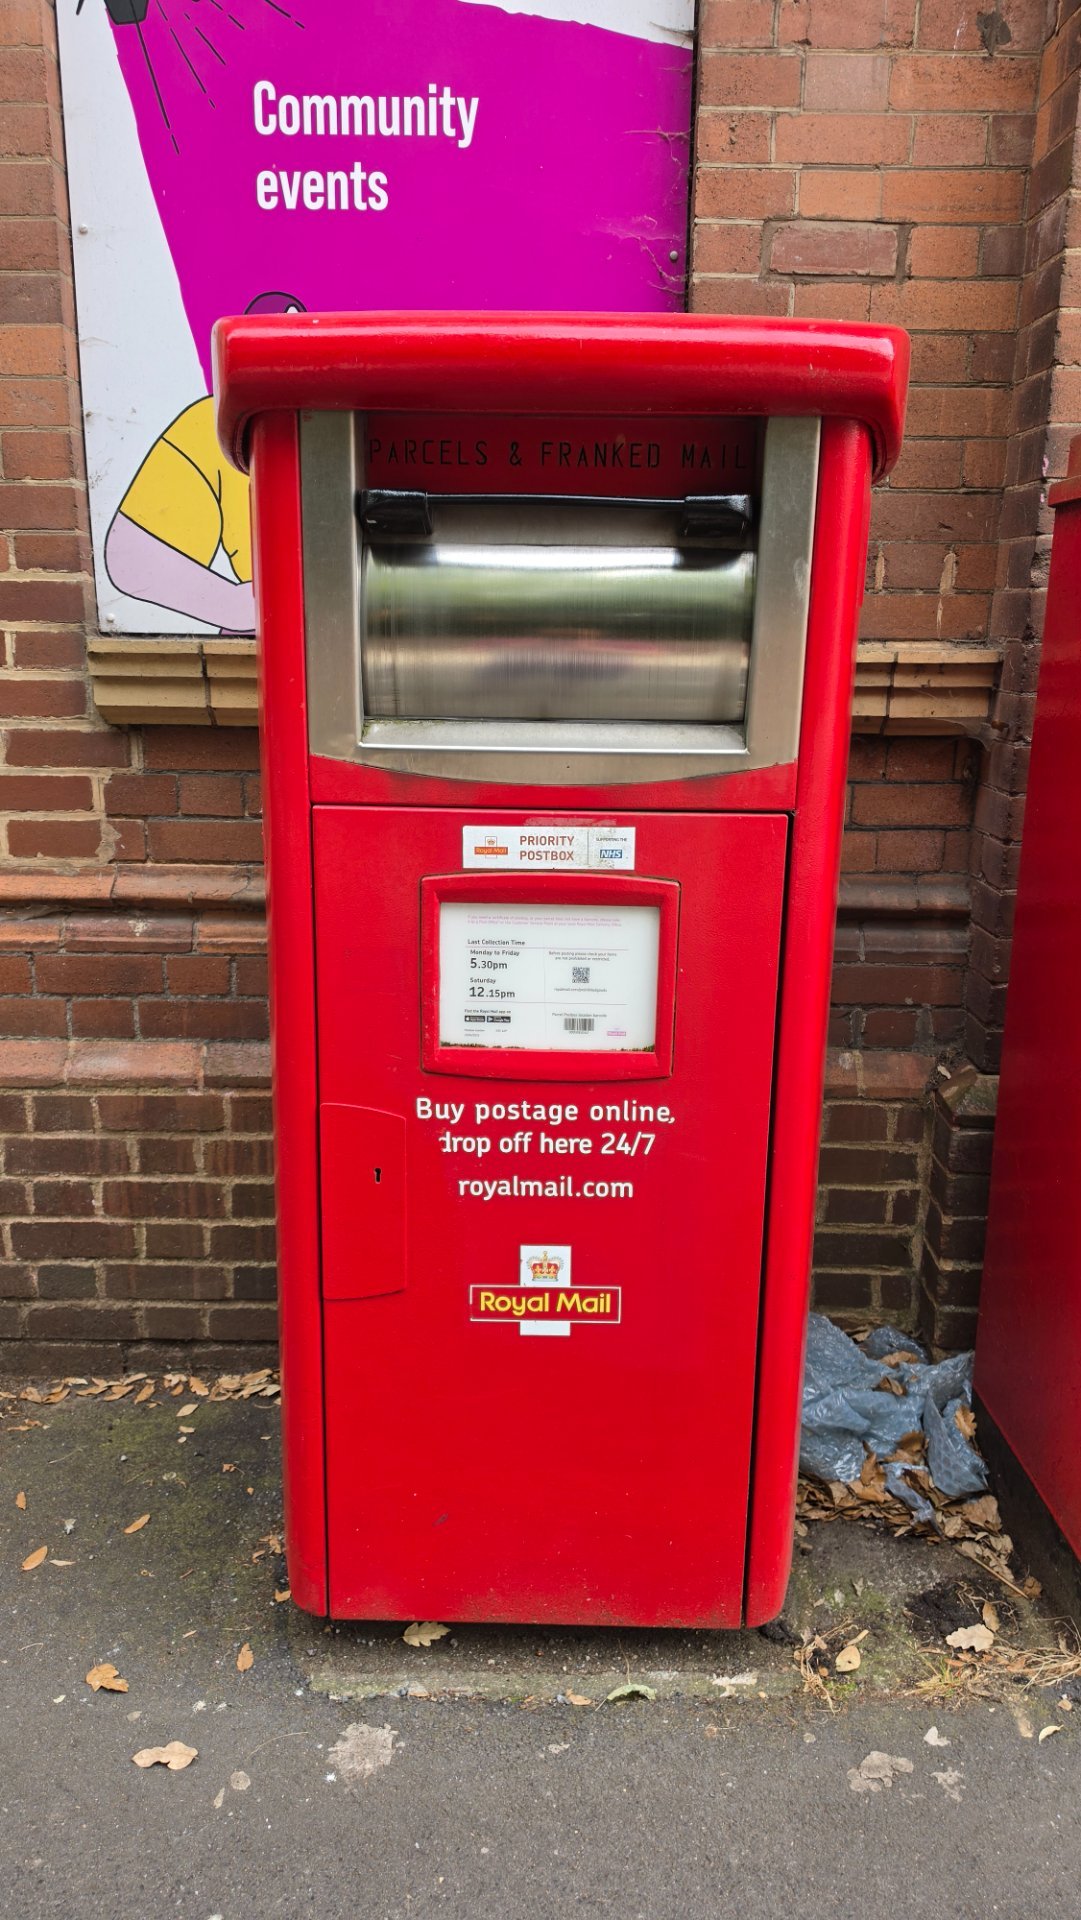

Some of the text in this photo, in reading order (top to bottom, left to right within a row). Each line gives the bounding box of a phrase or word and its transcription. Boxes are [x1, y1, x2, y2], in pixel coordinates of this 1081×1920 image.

[253, 80, 479, 149] Community
[256, 162, 389, 211] events
[369, 438, 749, 470] PARCELS & FRANKED MAIL
[519, 835, 575, 846] PRIORITY
[519, 850, 574, 861] POSTBOX
[601, 850, 621, 858] NHS
[470, 957, 508, 970] 5.30pm
[469, 986, 516, 999] 12.15pm
[416, 1097, 675, 1125] Buy postage online,
[499, 1131, 533, 1154] off
[540, 1132, 593, 1154] here
[601, 1131, 656, 1157] 24/7
[458, 1175, 634, 1200] royalmail.com
[480, 1291, 611, 1316] Royal Mail
